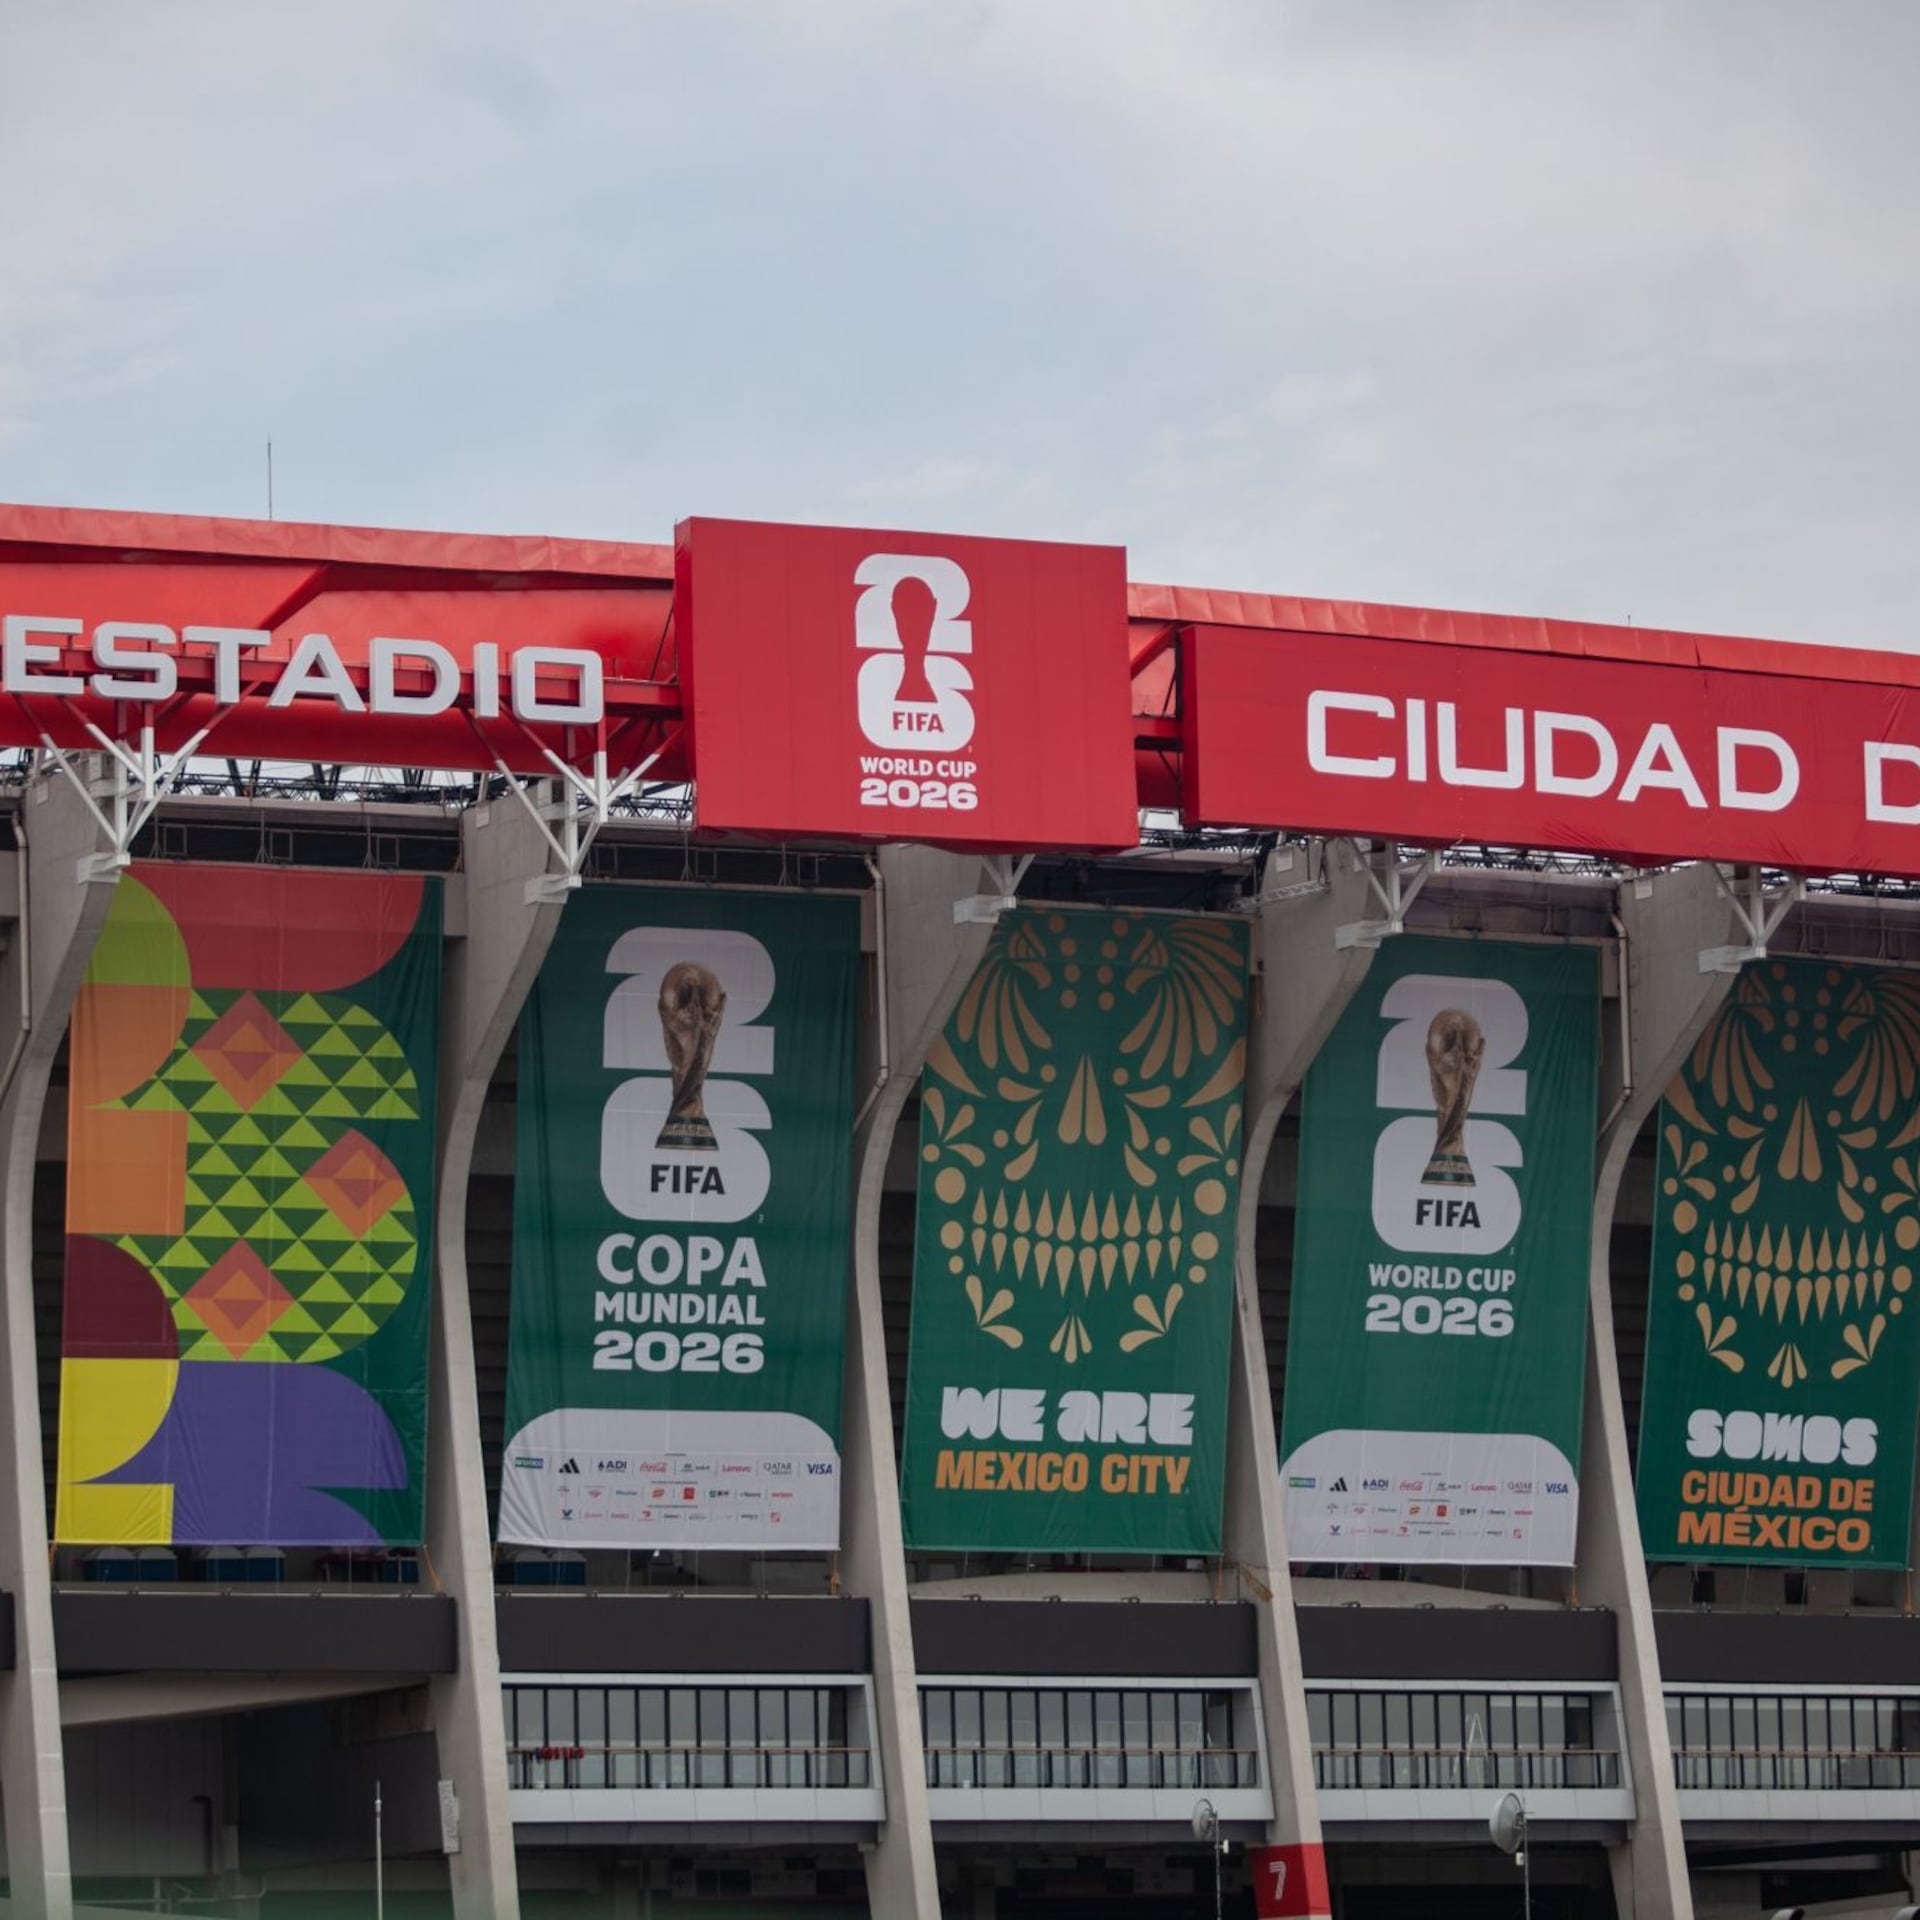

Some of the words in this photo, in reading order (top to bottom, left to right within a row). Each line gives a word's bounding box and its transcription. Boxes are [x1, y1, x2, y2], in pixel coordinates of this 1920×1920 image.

[3, 615, 603, 724] ESTADIO
[892, 711, 944, 733] FIFA
[860, 756, 933, 776] WORLD
[936, 760, 977, 778] CUP
[1307, 689, 1800, 811] CIUDAD
[860, 778, 978, 810] 2026
[650, 1164, 725, 1195] FIFA
[1415, 1199, 1481, 1228] FIFA
[596, 1233, 767, 1287] COPA
[1368, 1263, 1463, 1290] WORLD
[1466, 1267, 1516, 1292] CUP
[594, 1291, 766, 1325] MUNDIAL
[1365, 1294, 1514, 1337] 2026
[593, 1330, 765, 1374] 2026
[941, 1386, 1046, 1441] WE
[1686, 1408, 1879, 1467] SOMOS
[806, 1463, 833, 1475] VISA
[935, 1450, 1089, 1493] MEXICO
[1101, 1454, 1191, 1494] CITY
[1545, 1482, 1569, 1494] VISA
[1682, 1470, 1822, 1509] CIUDAD
[1828, 1477, 1875, 1512] DE
[1677, 1506, 1872, 1553] MÉXICO
[1269, 1860, 1287, 1900] 7
